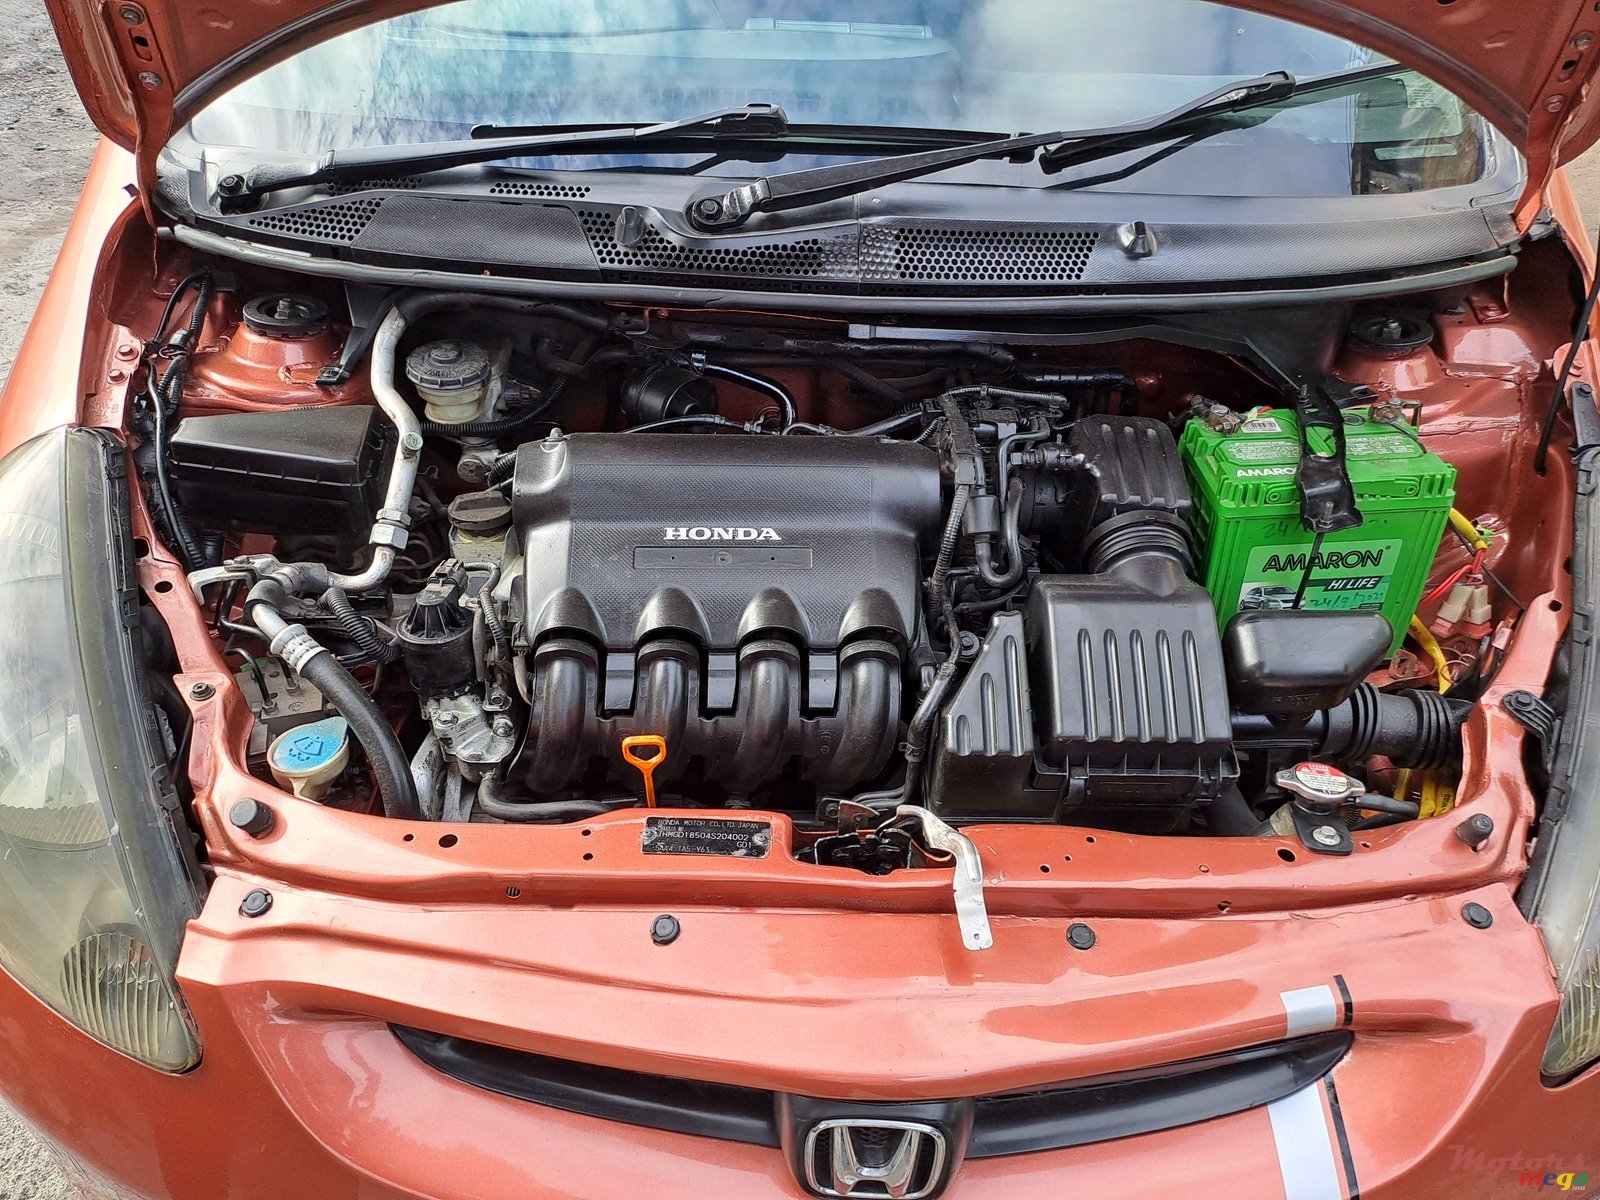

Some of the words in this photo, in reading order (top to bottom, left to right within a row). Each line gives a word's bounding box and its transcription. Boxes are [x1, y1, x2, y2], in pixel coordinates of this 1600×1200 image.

[1236, 467, 1297, 477] AMARO
[663, 527, 782, 541] HONDA
[1261, 549, 1384, 573] AMARON
[1327, 580, 1345, 590] HI
[1346, 577, 1380, 589] LIFE
[738, 822, 759, 830] JAPAN
